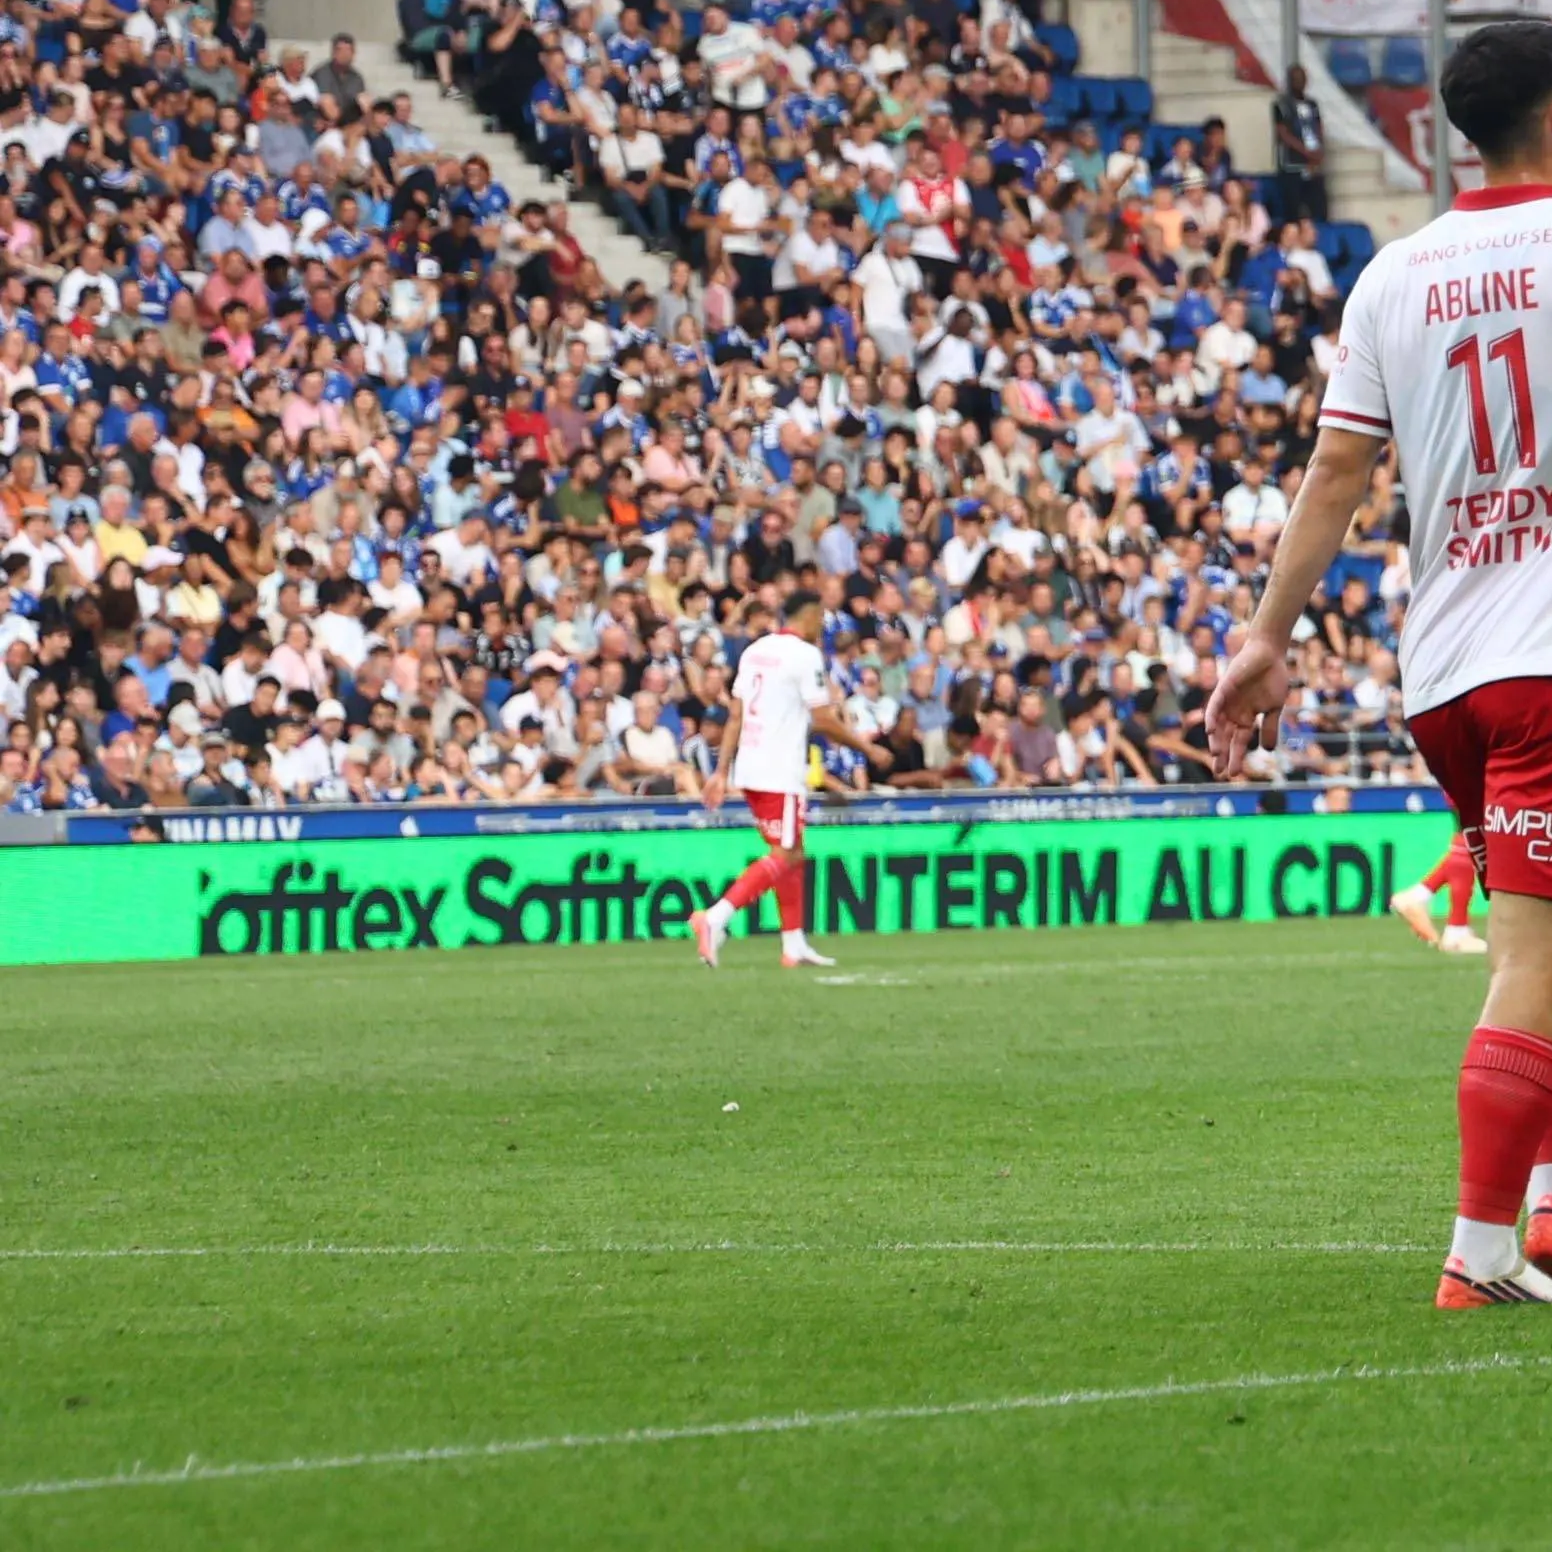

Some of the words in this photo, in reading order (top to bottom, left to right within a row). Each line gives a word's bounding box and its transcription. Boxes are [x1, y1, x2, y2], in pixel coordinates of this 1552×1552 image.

[1407, 244, 1457, 267] BANG
[1425, 267, 1539, 326] ABLINE
[1446, 327, 1538, 475] 11
[750, 673, 763, 716] 2
[200, 861, 447, 954] ofitex
[1147, 845, 1245, 923] AU
[1272, 842, 1396, 917] CDI
